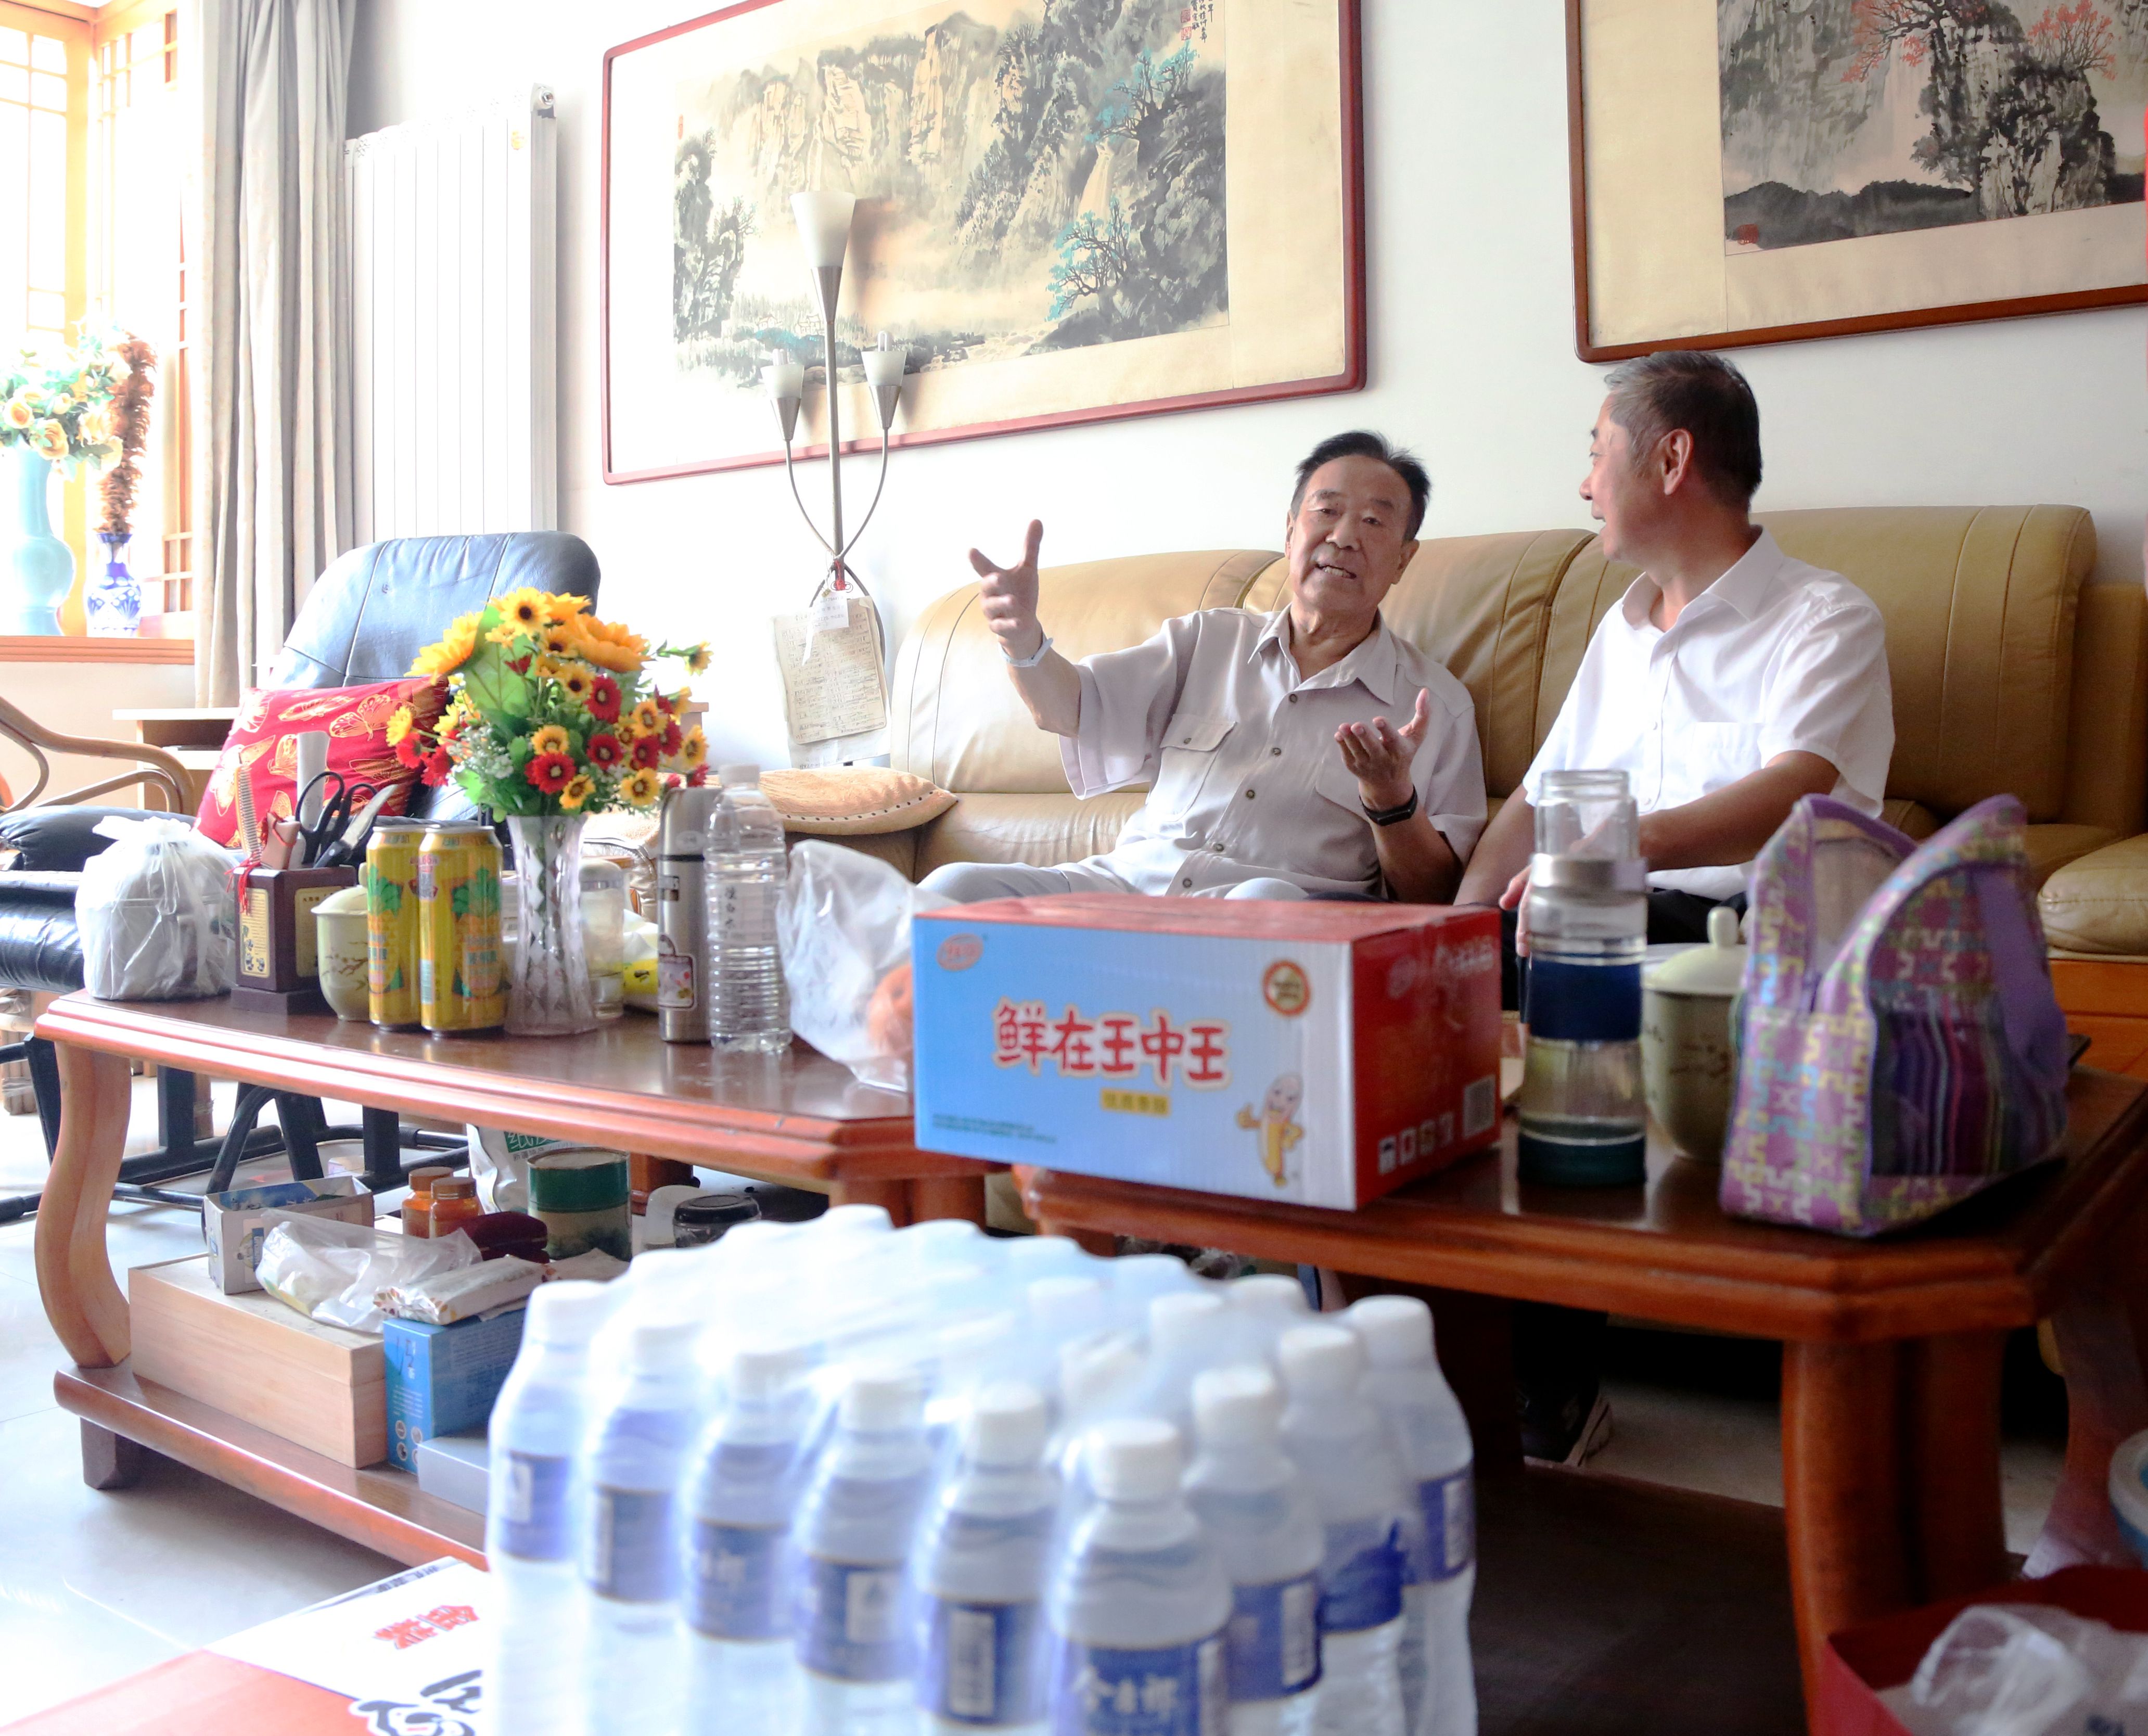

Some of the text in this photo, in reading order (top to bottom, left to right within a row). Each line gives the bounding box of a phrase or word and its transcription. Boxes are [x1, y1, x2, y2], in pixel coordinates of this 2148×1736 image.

[996, 1003, 1225, 1083] 鲜在王中王
